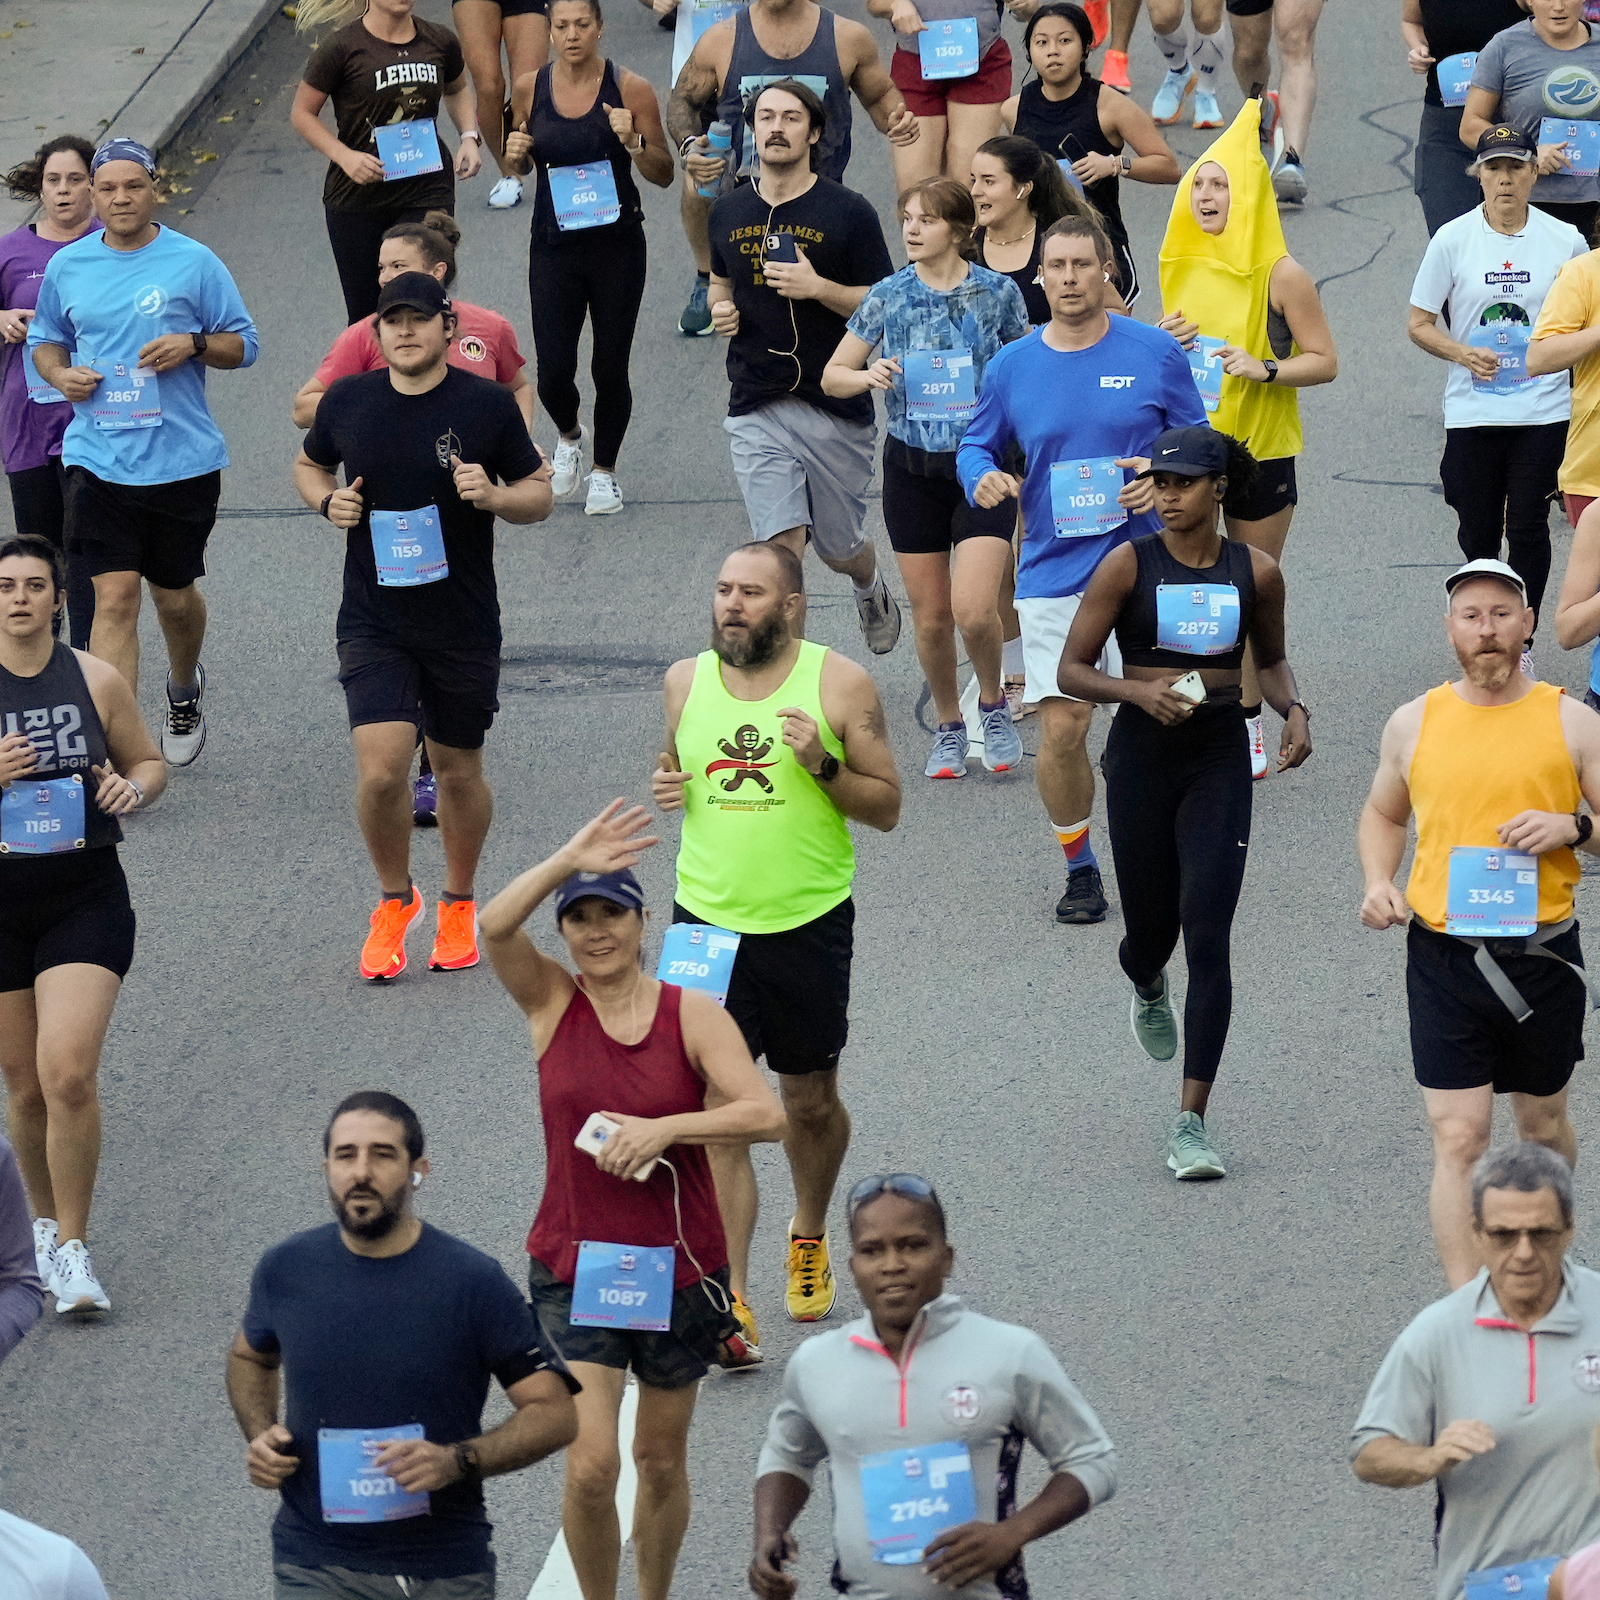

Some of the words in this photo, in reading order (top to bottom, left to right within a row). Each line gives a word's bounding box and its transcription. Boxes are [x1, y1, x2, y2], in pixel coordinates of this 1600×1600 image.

[935, 45, 964, 57] 1303
[375, 61, 438, 91] LEHIGH
[393, 149, 424, 163] 1954
[572, 191, 597, 205] 650
[1486, 273, 1529, 285] Heineken
[922, 382, 956, 395] 2871
[1099, 376, 1136, 389] EQT
[105, 390, 140, 402] 2867
[914, 411, 928, 420] Gear
[930, 410, 952, 419] Check
[1068, 493, 1106, 508] 1030
[1062, 526, 1079, 536] Gear
[1080, 525, 1102, 534] Check
[392, 545, 422, 557] 1159
[1177, 621, 1218, 635] 2875
[22, 707, 58, 772] RUN
[57, 755, 88, 769] PGH
[26, 819, 62, 833] 1185
[1467, 889, 1514, 904] 3345
[668, 960, 709, 976] 2750
[599, 1288, 648, 1307] 1087
[948, 1386, 981, 1423] 10
[890, 1495, 950, 1522] 2764
